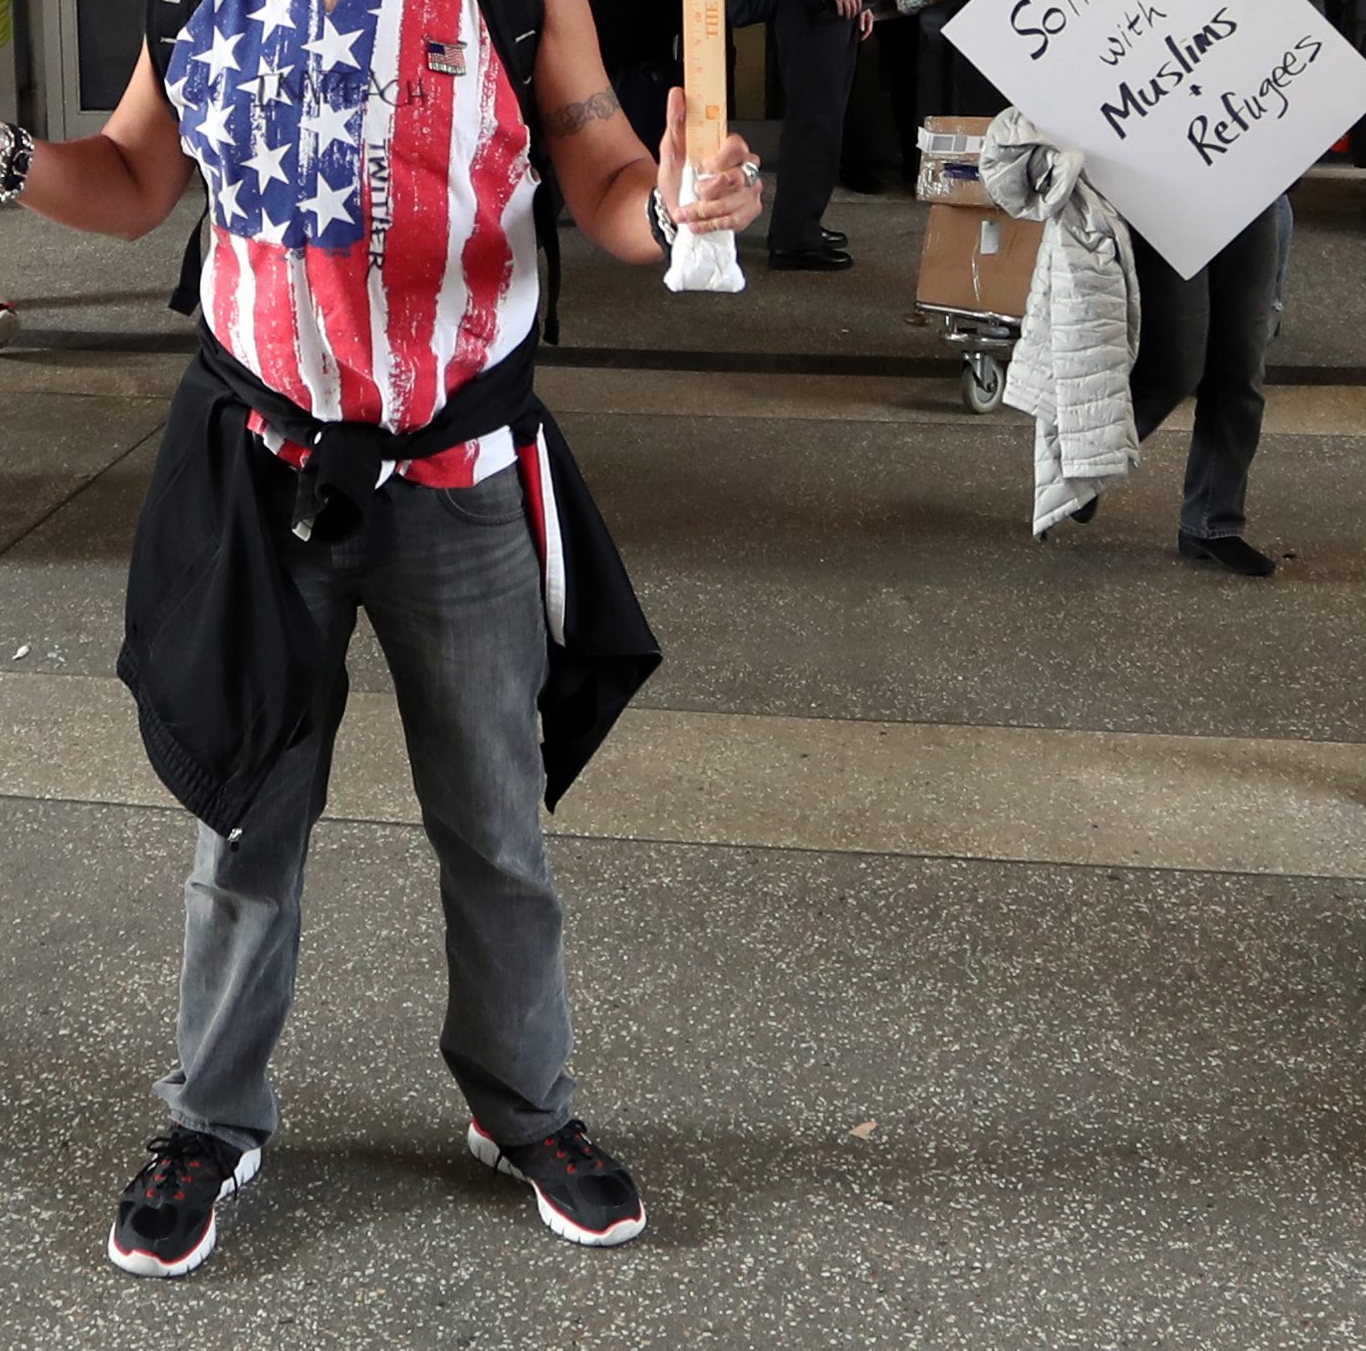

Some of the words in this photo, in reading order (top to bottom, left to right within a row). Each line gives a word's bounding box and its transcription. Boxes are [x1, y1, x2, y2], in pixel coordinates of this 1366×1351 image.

[705, 2, 720, 40] THE
[1098, 0, 1168, 67] with
[1099, 6, 1239, 140] Muslims
[1186, 34, 1323, 167] Refugees
